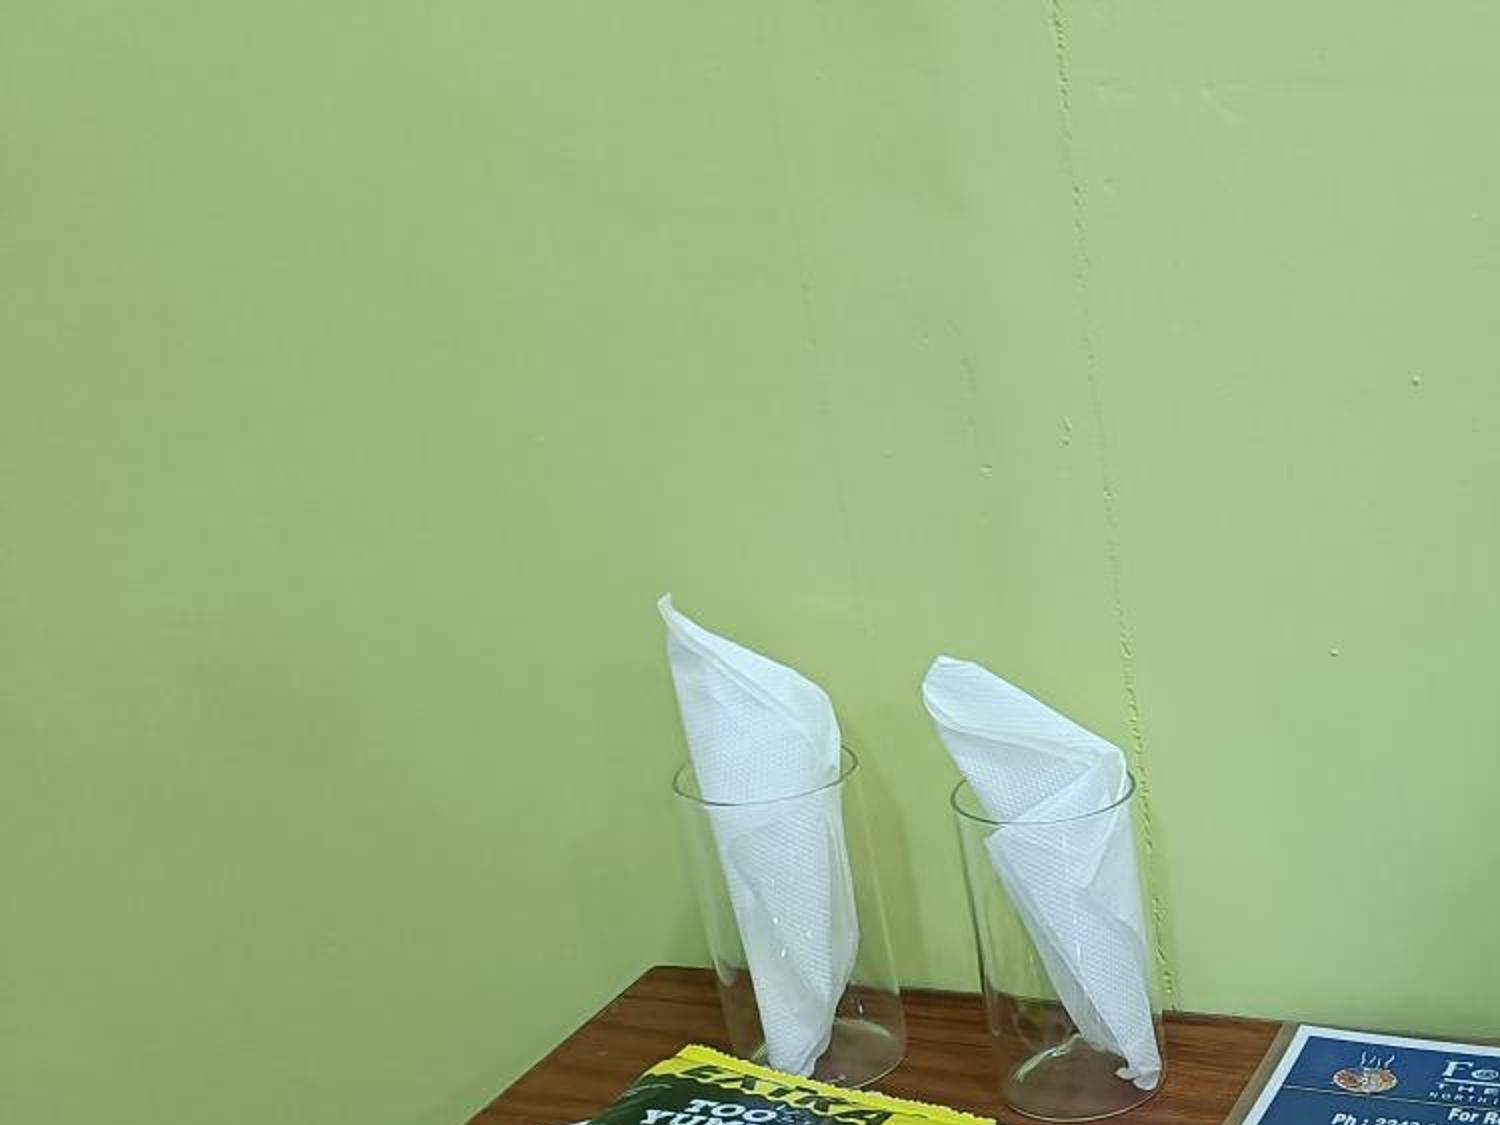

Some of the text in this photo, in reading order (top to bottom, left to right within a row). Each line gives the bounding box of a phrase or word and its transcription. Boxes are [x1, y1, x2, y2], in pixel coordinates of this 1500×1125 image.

[684, 1099, 777, 1123] TOO
[1448, 1108, 1480, 1122] For
[1331, 1113, 1358, 1125] Ph
